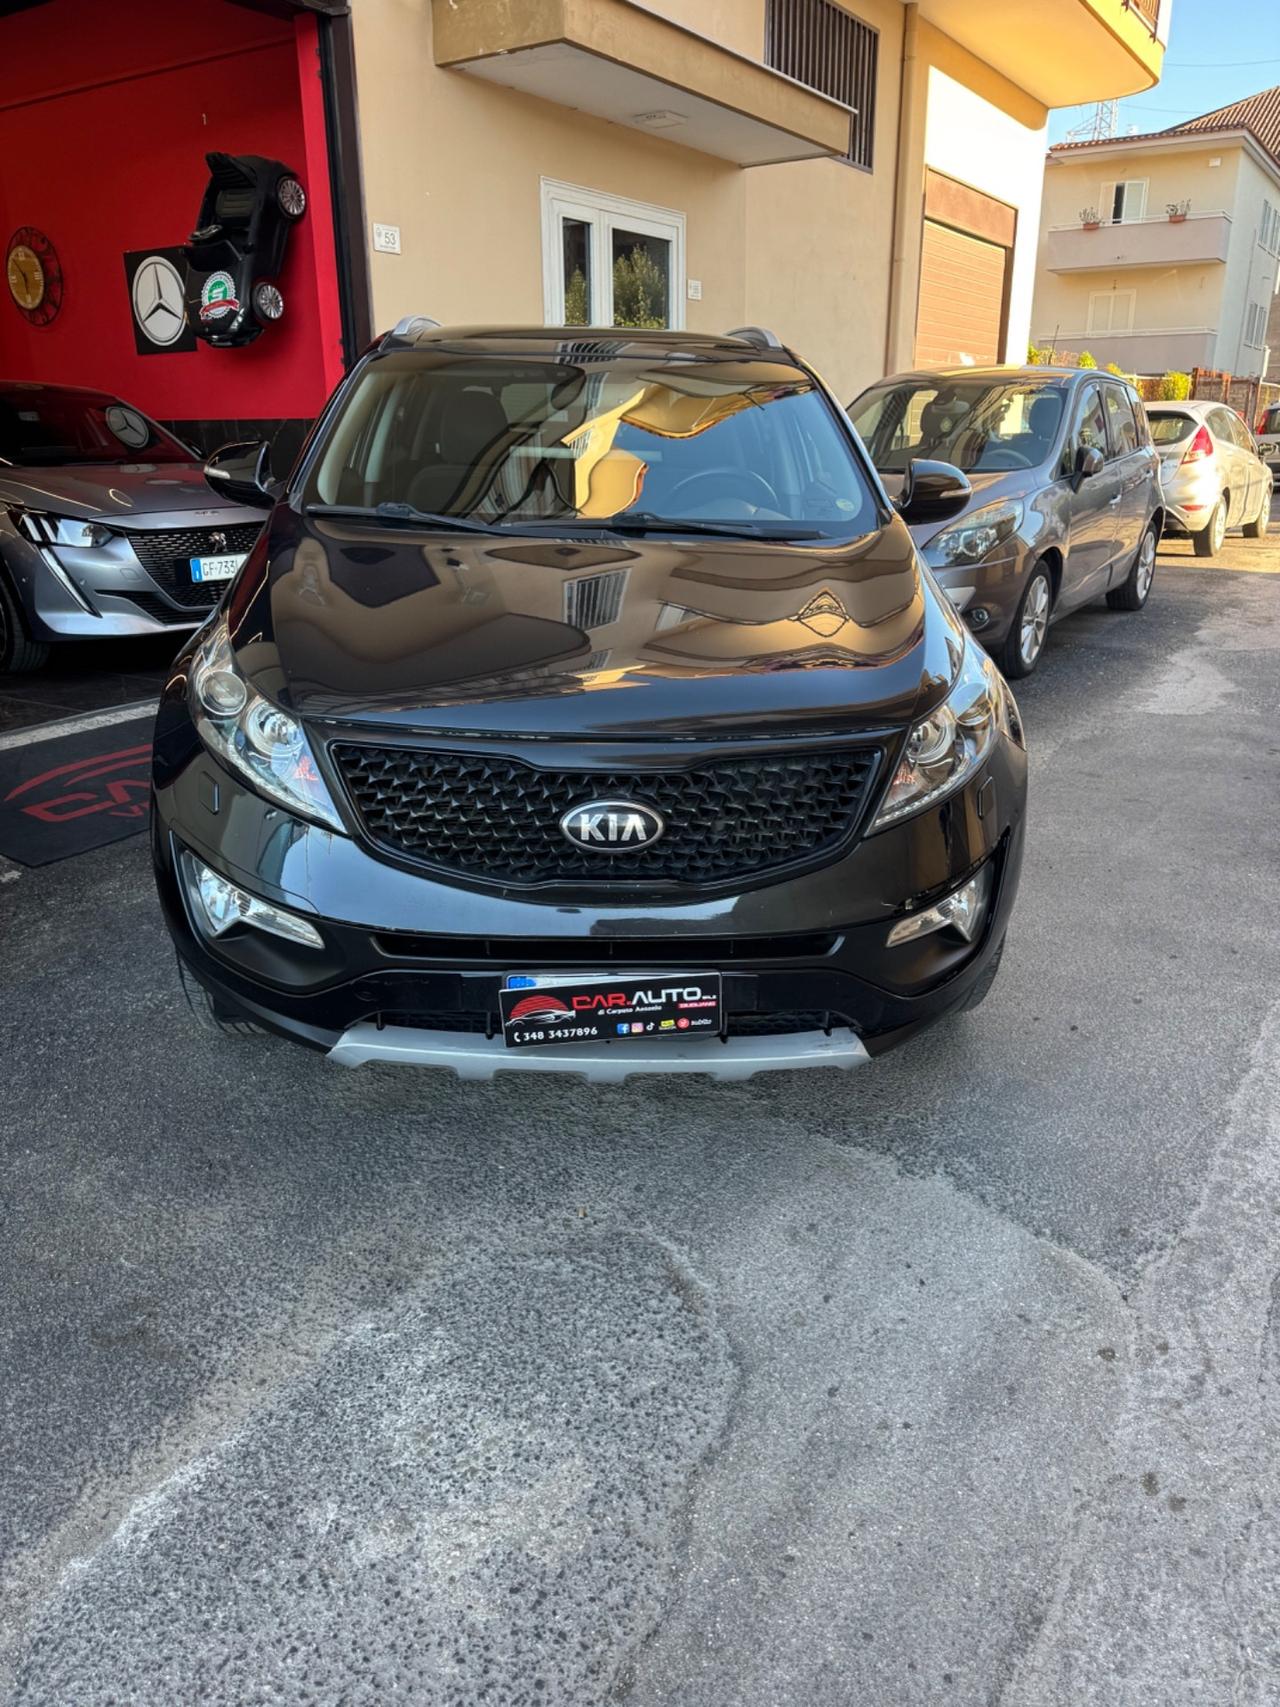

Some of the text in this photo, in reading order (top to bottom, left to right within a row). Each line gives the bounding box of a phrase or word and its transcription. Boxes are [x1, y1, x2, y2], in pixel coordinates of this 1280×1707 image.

[384, 231, 397, 246] 53
[580, 813, 648, 841] KIA
[523, 1026, 598, 1041] 348 3437896
